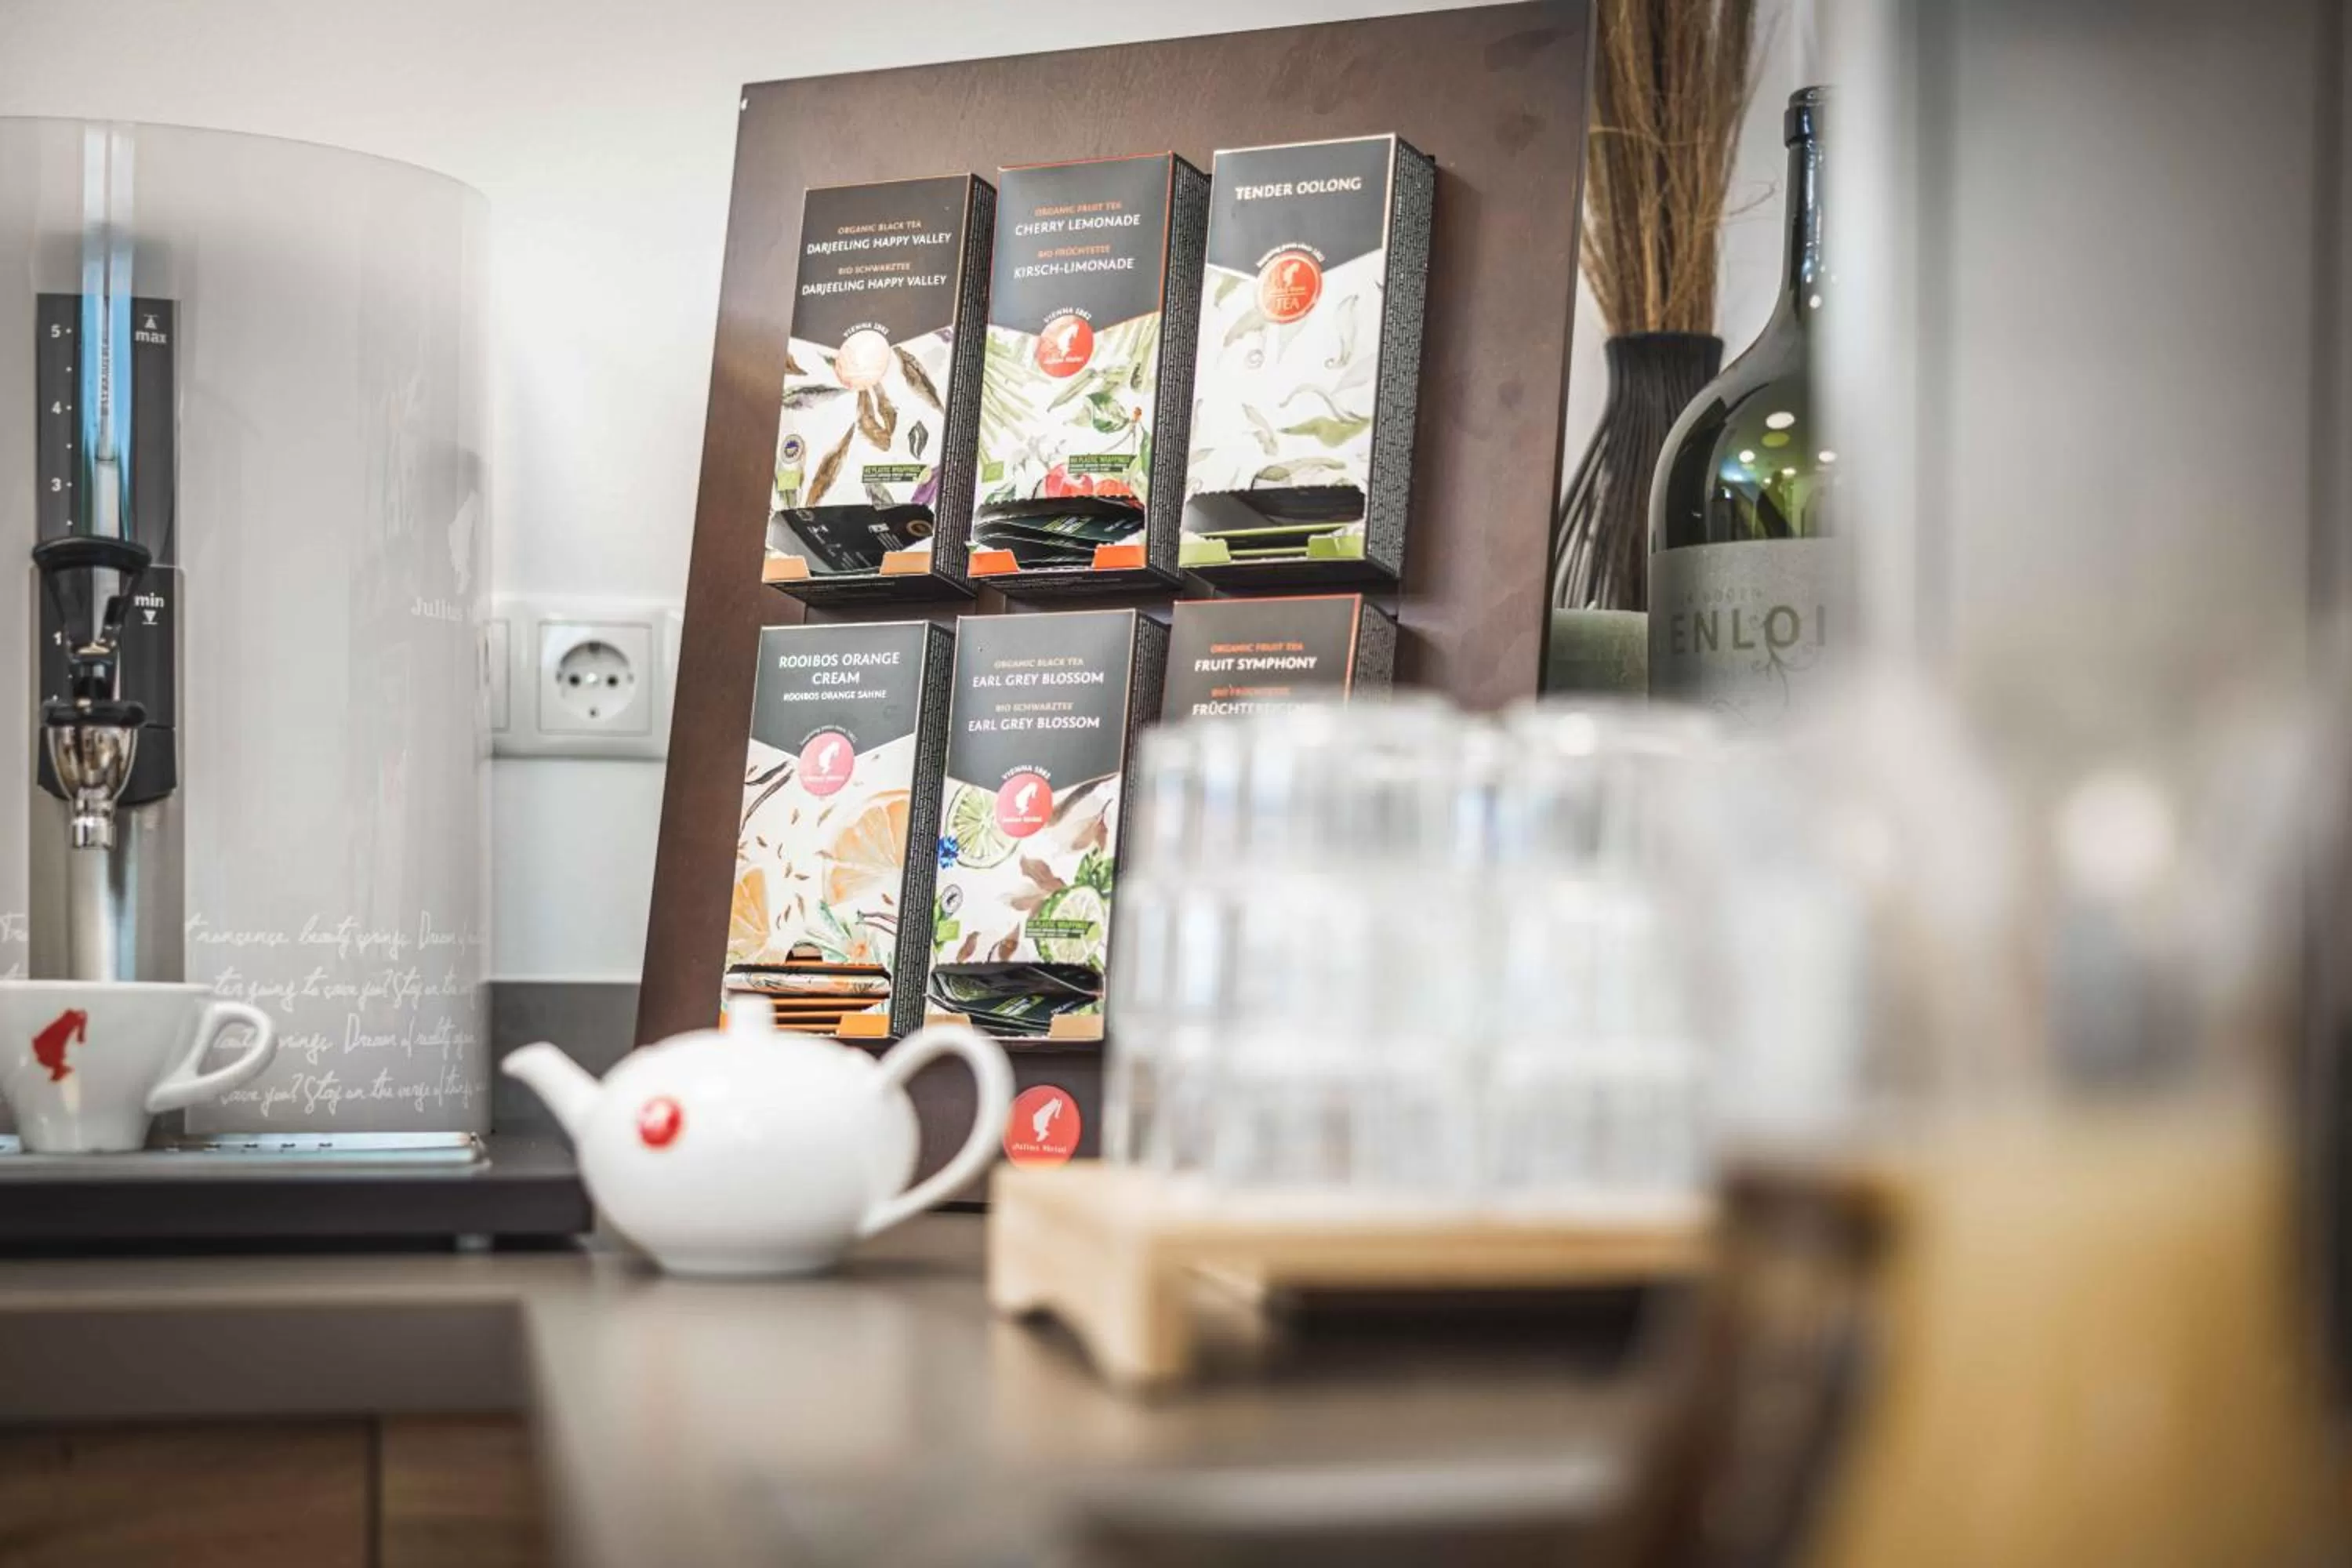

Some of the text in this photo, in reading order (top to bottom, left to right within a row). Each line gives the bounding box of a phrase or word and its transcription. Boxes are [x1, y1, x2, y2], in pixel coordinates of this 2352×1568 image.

[1235, 176, 1363, 200] TENDER OOLONG
[837, 223, 875, 234] ORGANIC
[906, 220, 922, 229] TEA
[1015, 214, 1142, 236] CHERRY LEMONADE
[807, 232, 953, 255] DARJEELING HAPPY VALLEY
[1013, 258, 1136, 279] KIRSCH-LIMONADE
[802, 275, 947, 296] DARJEELING HAPPY VALLEY
[51, 324, 62, 338] 5
[134, 330, 168, 343] max
[51, 401, 62, 415] 4
[50, 477, 62, 492] 3
[134, 592, 165, 608] min
[53, 630, 62, 645] 1
[779, 652, 902, 669] ROOIBOS ORANGE
[1194, 656, 1318, 672] FRUIT SYMPHONY
[811, 671, 861, 684] CREAM
[972, 670, 1105, 688] EARL GREY BLOSSOM
[783, 689, 888, 702] ROOIBOS ORANGE SAHNE
[967, 717, 1101, 731] EARL GREY BLOSSOM
